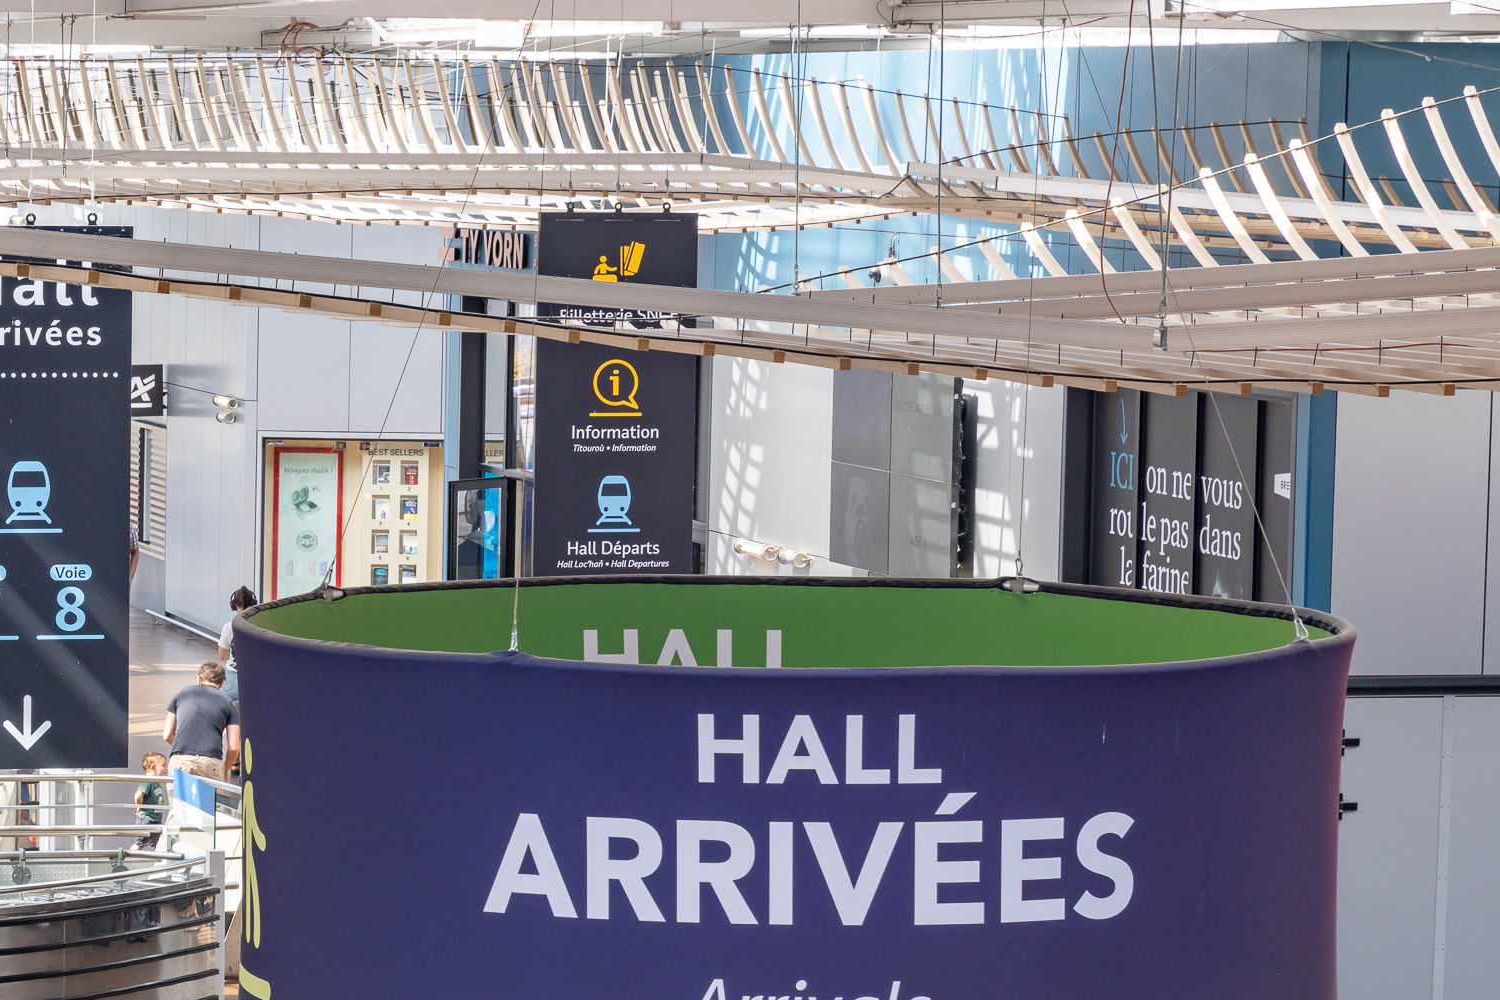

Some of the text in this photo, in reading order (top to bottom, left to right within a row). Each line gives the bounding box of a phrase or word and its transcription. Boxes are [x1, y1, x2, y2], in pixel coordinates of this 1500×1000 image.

[460, 229, 524, 270] TY VORN
[572, 425, 660, 439] Information
[573, 444, 656, 452] Titouroù Information
[1110, 451, 1242, 510] ICI on ne vous
[567, 541, 660, 558] Hall Départs
[1159, 514, 1241, 561] pas dans
[55, 566, 87, 579] Voie
[557, 560, 573, 568] Hall
[611, 559, 627, 568] Hall
[628, 559, 669, 569] Departures
[1142, 550, 1189, 595] farine
[55, 586, 86, 632] 8
[696, 714, 943, 786] HALL
[482, 792, 1135, 927] ARRIVÉES
